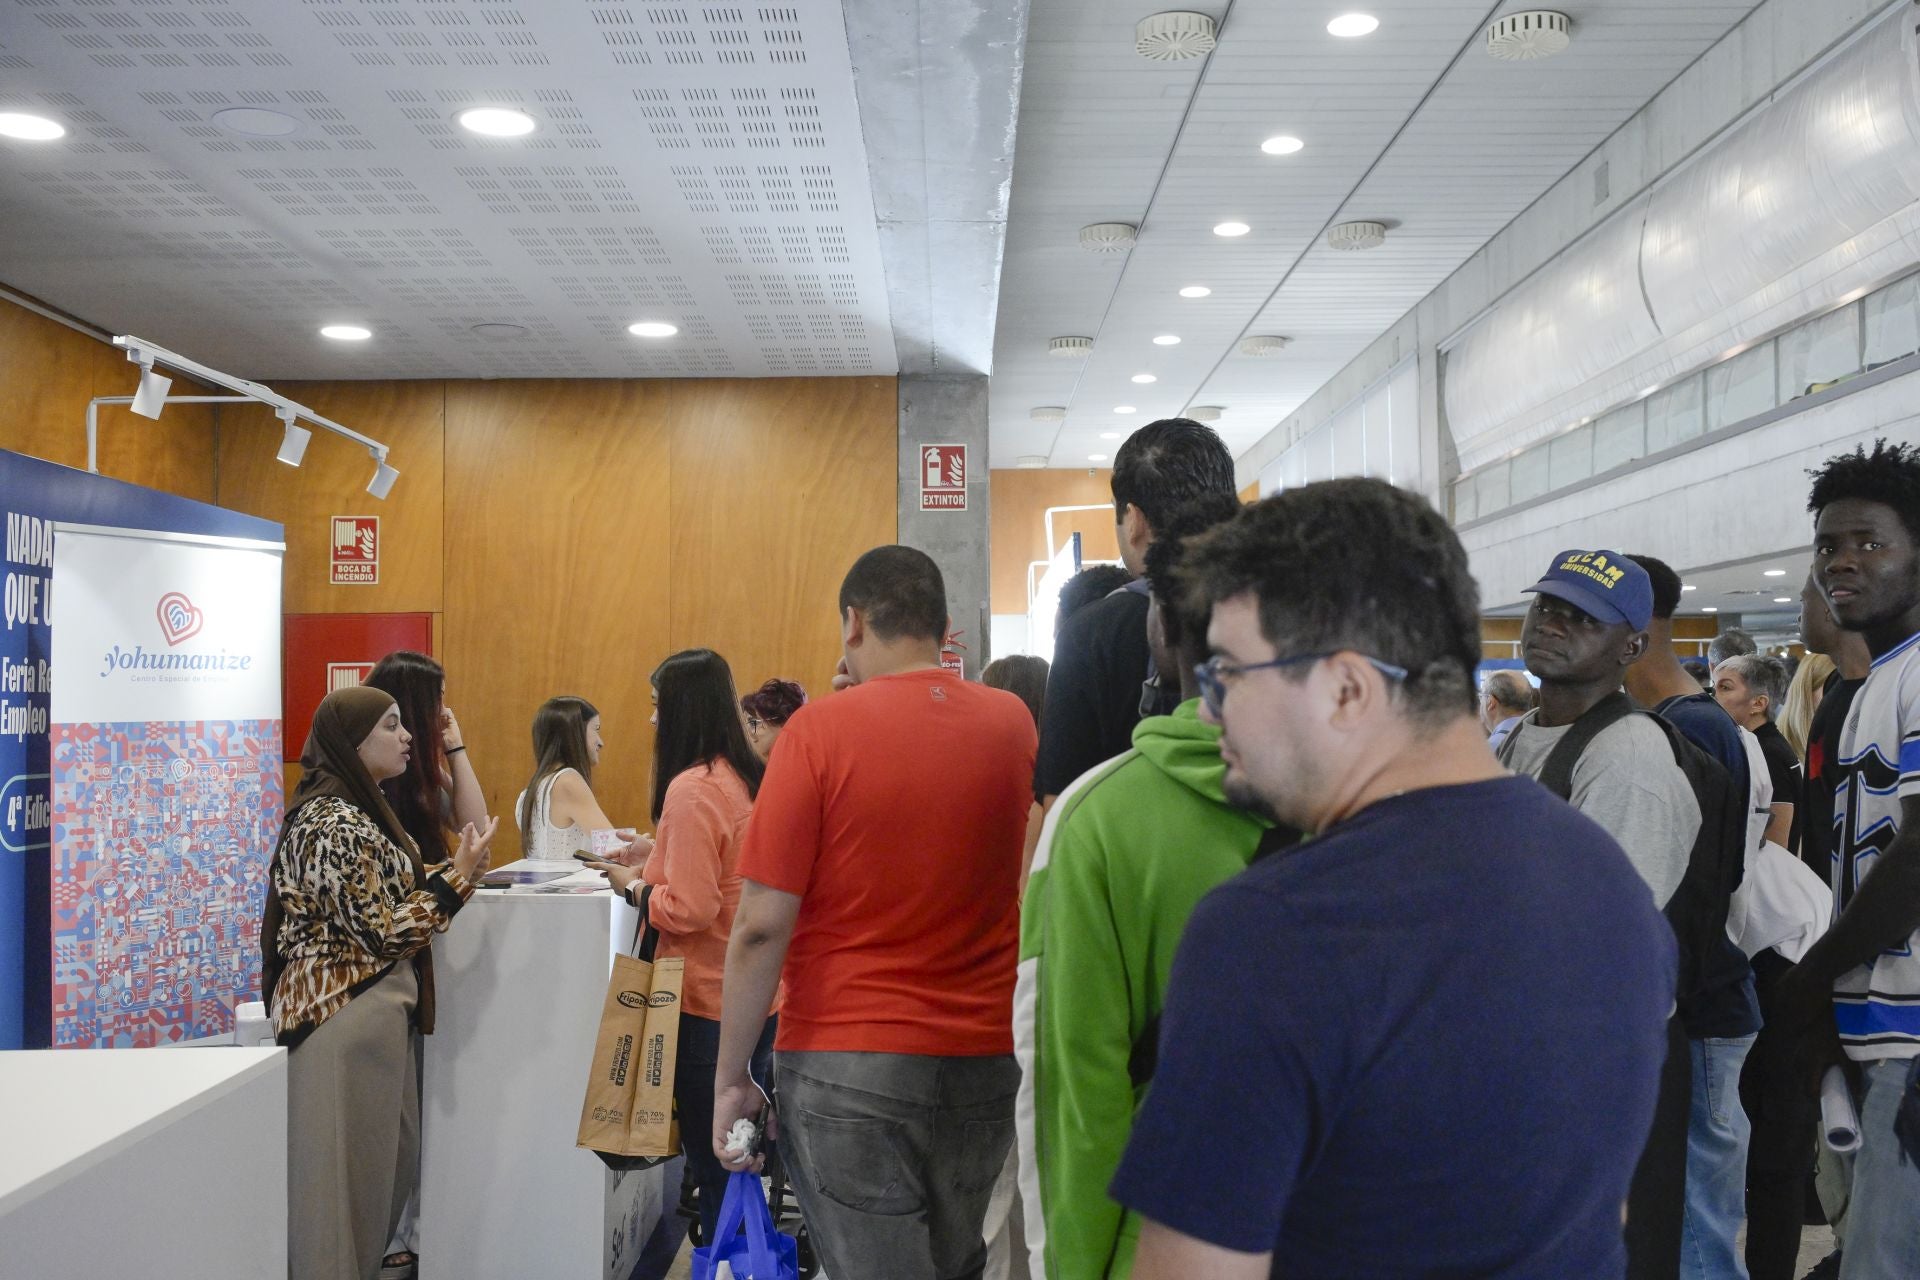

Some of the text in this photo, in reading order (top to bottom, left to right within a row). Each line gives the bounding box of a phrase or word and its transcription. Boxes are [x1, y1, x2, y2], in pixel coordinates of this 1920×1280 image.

[923, 494, 965, 505] EXTINTOR
[6, 511, 53, 568] NADA
[335, 572, 374, 581] INCENDIO
[337, 565, 372, 573] BOCA DE
[1560, 562, 1615, 589] UNIVERSIDAD
[1567, 552, 1625, 582] UCAM
[4, 572, 40, 630] QUE
[1, 656, 36, 693] Feria
[100, 645, 251, 678] yohumanize
[130, 674, 157, 683] Centro
[1, 699, 47, 743] Empleo
